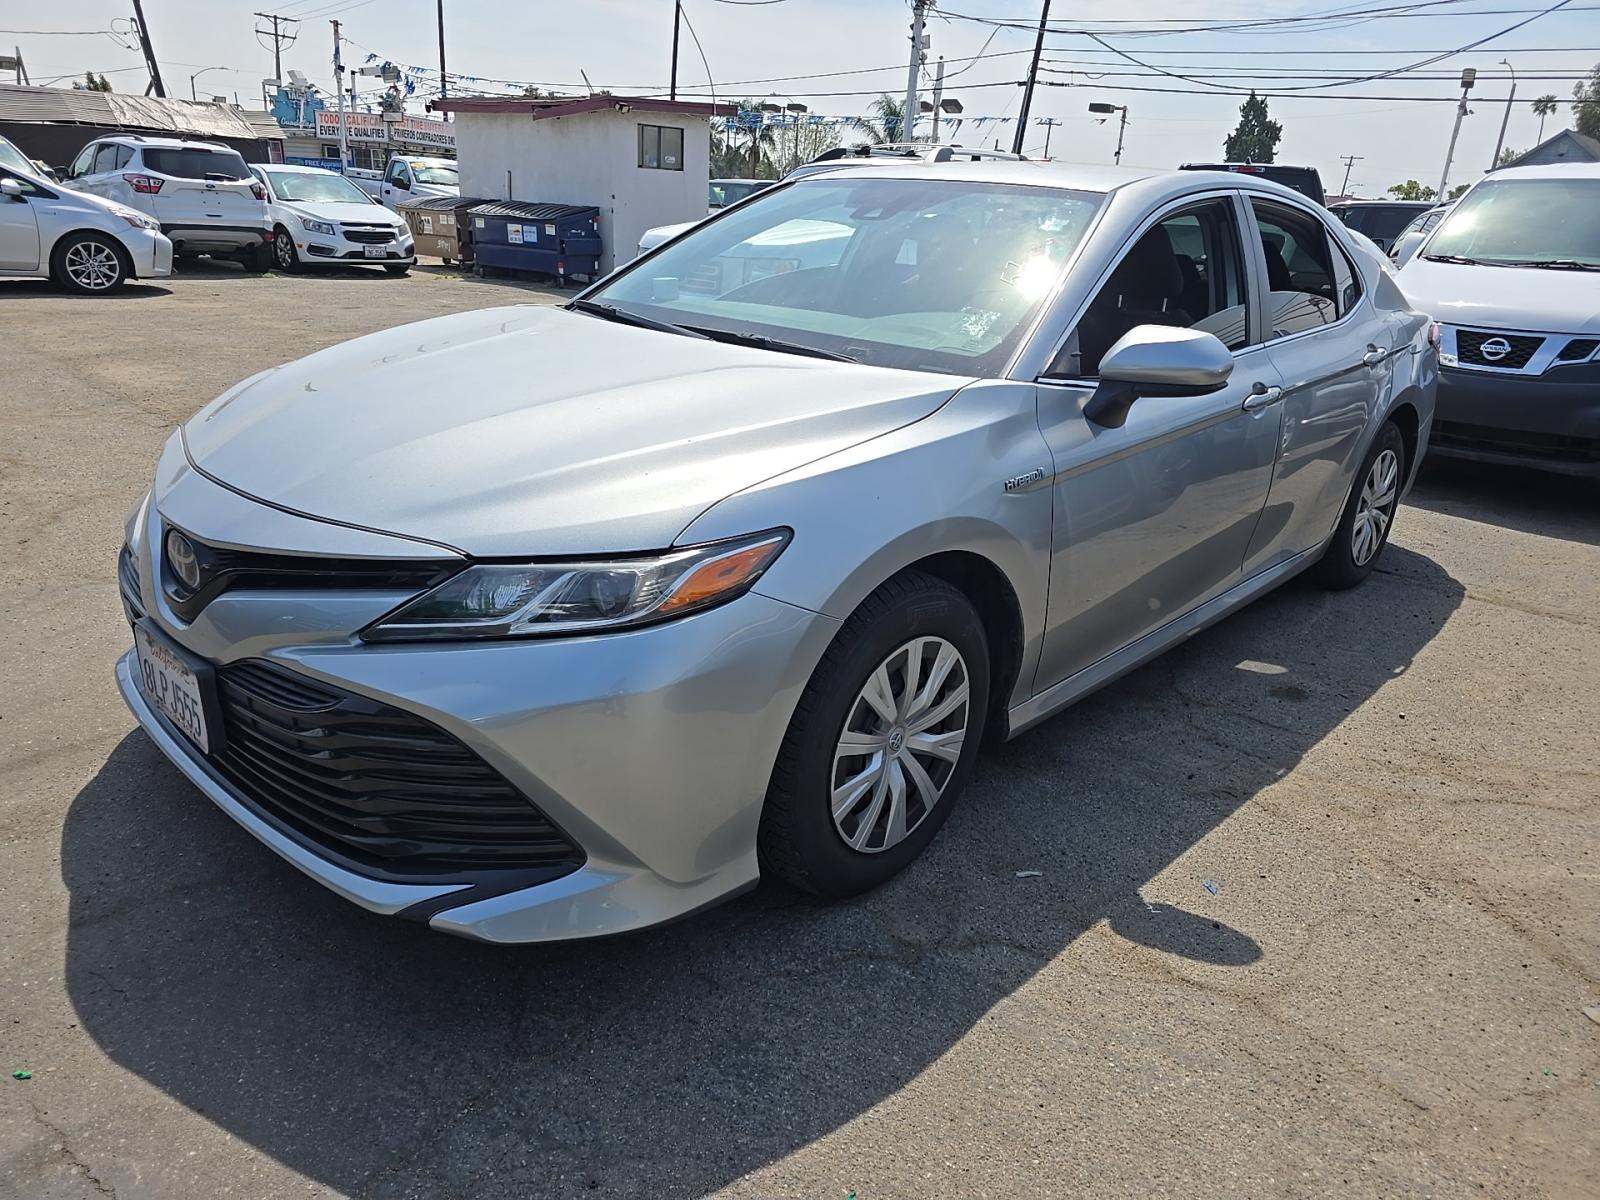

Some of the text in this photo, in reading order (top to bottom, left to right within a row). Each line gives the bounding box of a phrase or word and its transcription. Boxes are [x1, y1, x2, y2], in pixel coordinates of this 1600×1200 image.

[318, 113, 340, 124] TODO
[320, 125, 385, 139] EVERYE QUALIFIES
[304, 159, 320, 168] FREE
[1004, 467, 1044, 491] HYBRID
